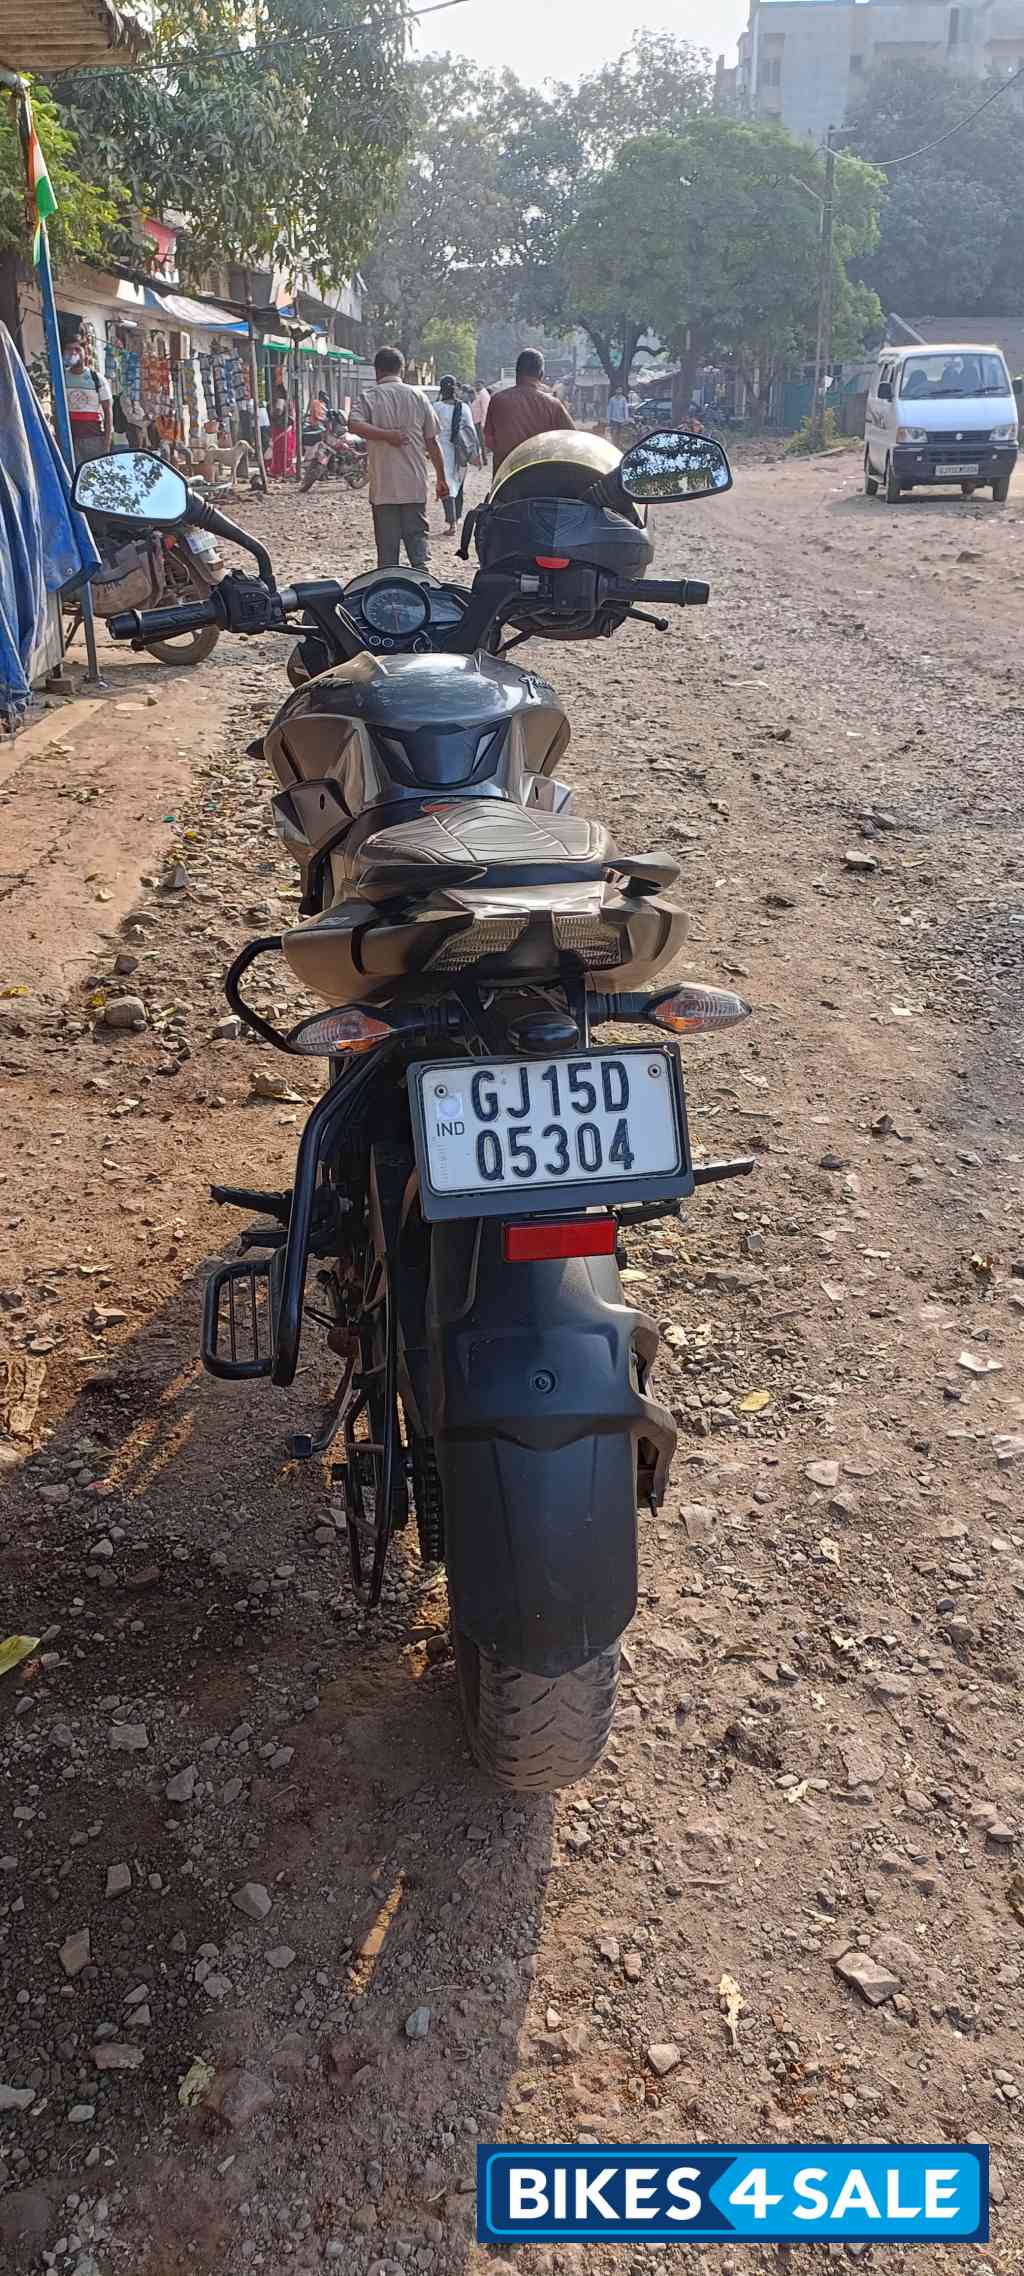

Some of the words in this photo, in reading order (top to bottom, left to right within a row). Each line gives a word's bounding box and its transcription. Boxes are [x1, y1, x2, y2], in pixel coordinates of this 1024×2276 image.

[471, 1061, 630, 1122] GJ15D
[436, 1121, 465, 1137] IND
[475, 1118, 635, 1181] Q5304
